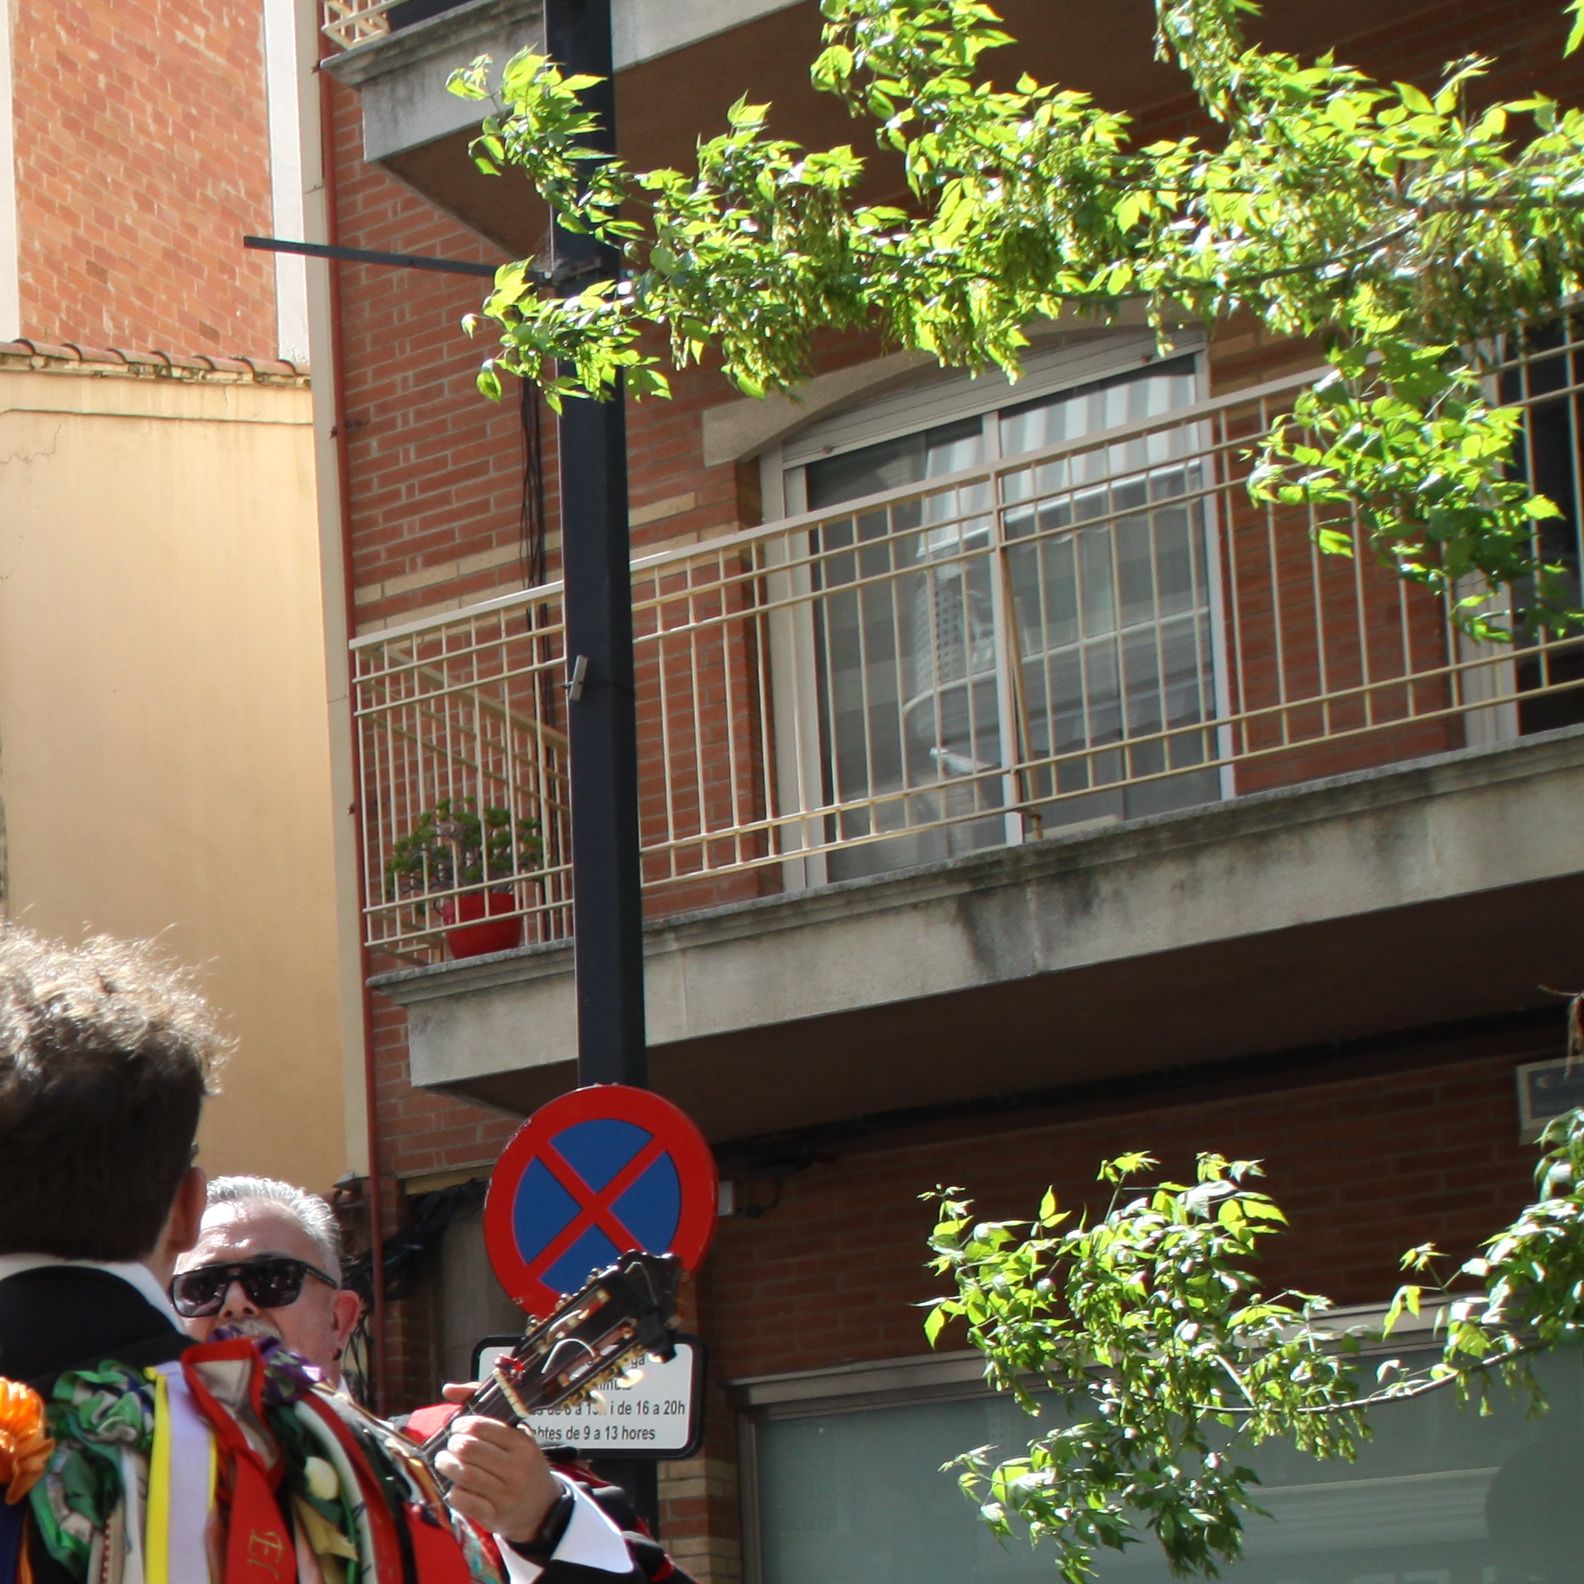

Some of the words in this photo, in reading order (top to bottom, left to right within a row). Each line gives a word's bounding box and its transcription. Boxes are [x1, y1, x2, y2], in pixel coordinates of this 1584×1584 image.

[617, 1400, 632, 1414] de
[637, 1400, 649, 1414] 16
[652, 1404, 660, 1414] a
[663, 1400, 685, 1414] 20h
[566, 1426, 581, 1440] de
[583, 1426, 591, 1440] 9
[594, 1429, 601, 1440] a
[606, 1426, 618, 1440] 13
[621, 1426, 656, 1440] hores
